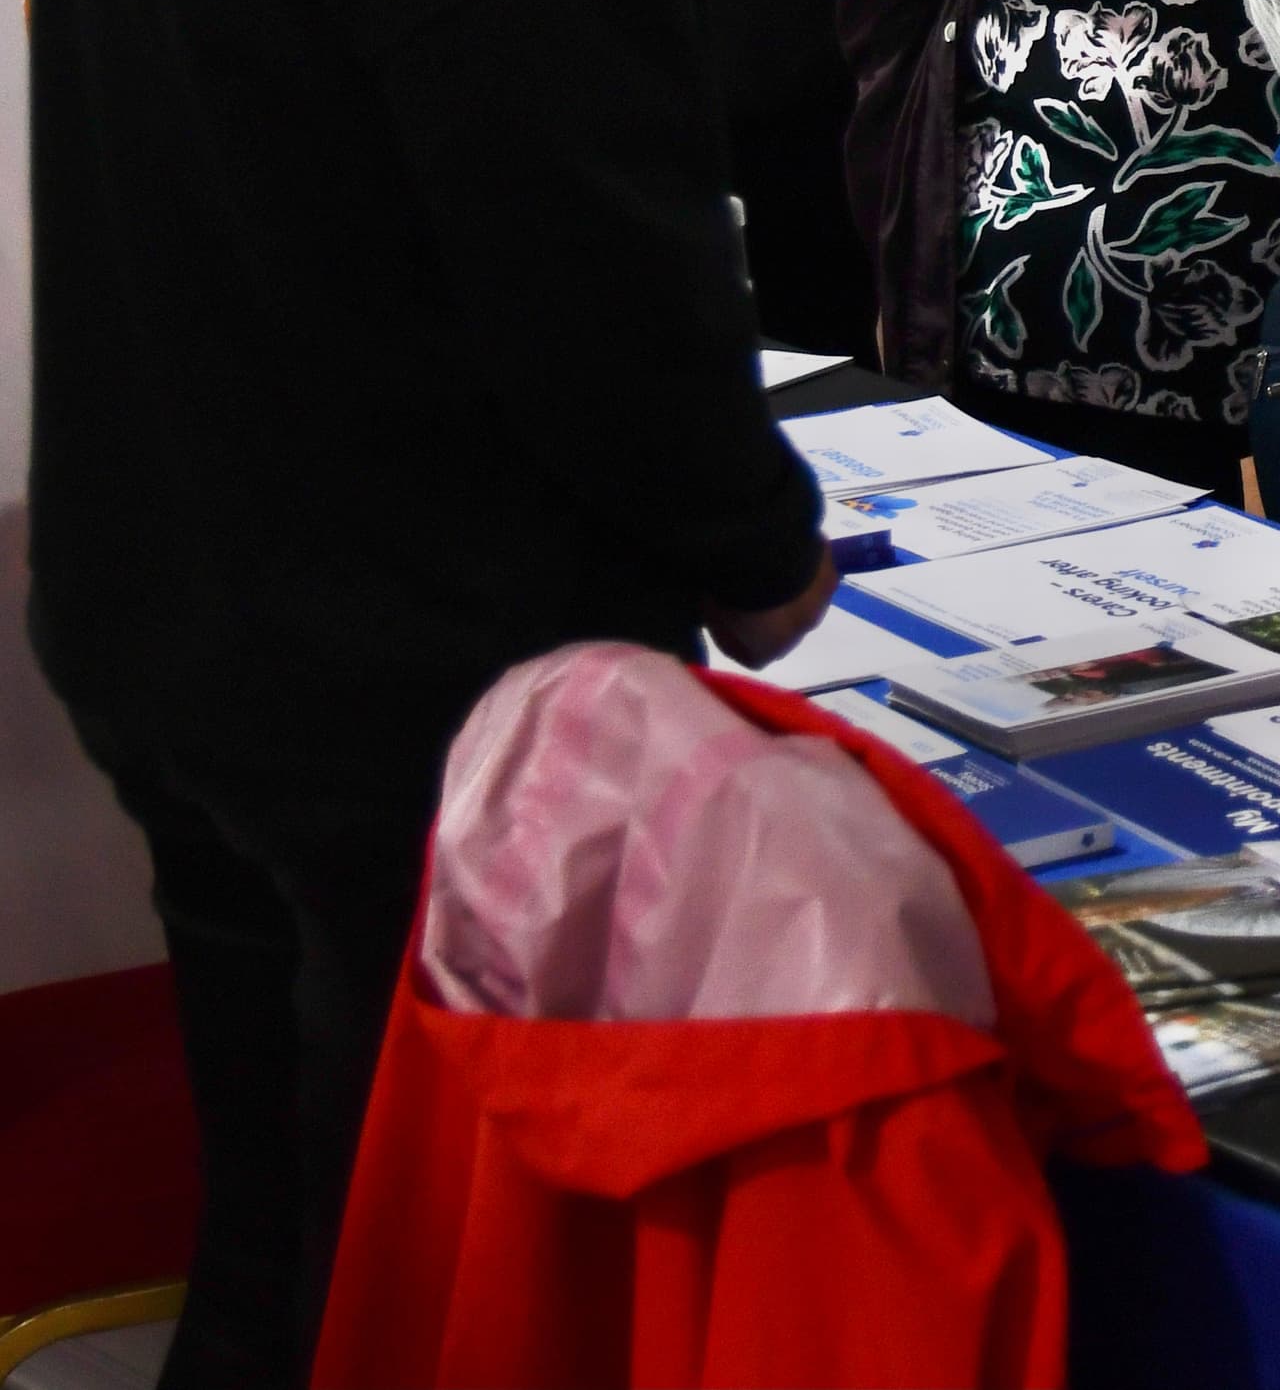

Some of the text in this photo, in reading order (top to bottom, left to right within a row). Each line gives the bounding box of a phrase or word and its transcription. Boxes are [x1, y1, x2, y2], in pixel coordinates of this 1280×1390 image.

[1038, 558, 1179, 612] looking after
[1063, 585, 1138, 618] Carers
[1225, 809, 1280, 835] My
